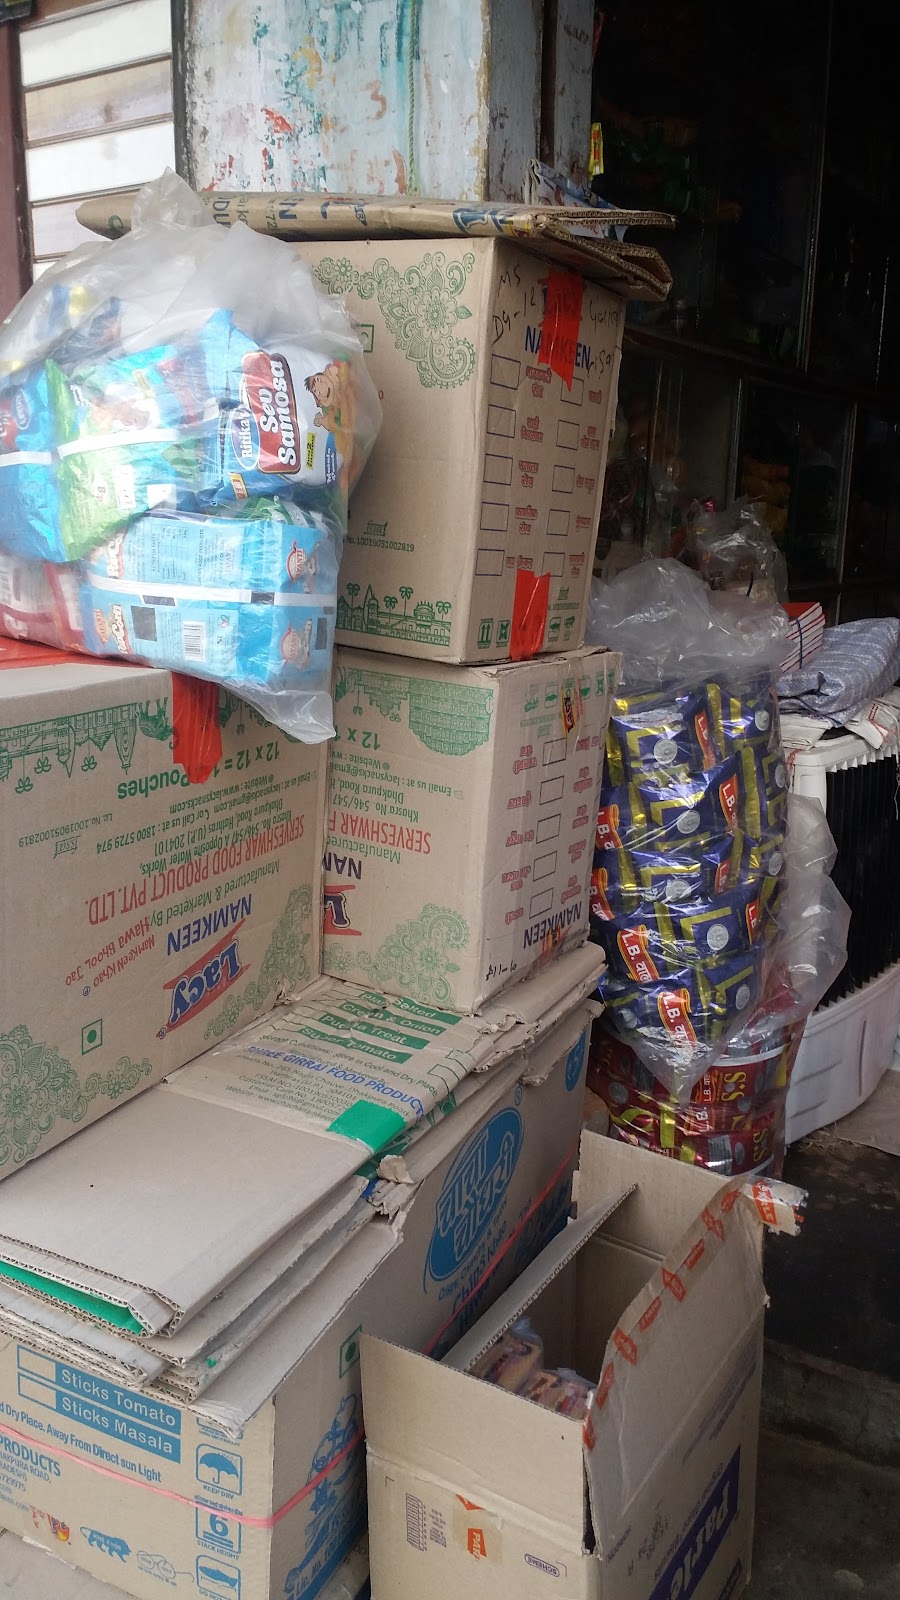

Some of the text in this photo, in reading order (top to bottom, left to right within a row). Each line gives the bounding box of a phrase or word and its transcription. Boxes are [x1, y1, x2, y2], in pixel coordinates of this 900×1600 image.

[270, 360, 297, 466] Samosa
[347, 728, 357, 742] x
[362, 731, 381, 750] 12
[237, 750, 250, 770] 12
[266, 741, 280, 760] 12
[350, 754, 381, 770] Website
[117, 769, 190, 800] Pouches
[406, 778, 415, 788] at
[417, 781, 427, 791] us
[429, 782, 452, 797] Email
[169, 775, 268, 814] Website www.lacysnacks.com
[362, 786, 404, 805] Dhakpura
[722, 784, 734, 813] L.B.
[185, 813, 196, 827] Call
[332, 798, 419, 823] Khasra No. 546/547
[137, 824, 156, 840] 1800
[162, 821, 170, 832] at
[172, 819, 181, 828] us
[208, 815, 235, 834] Hathras
[341, 813, 432, 855] SERVESHWAR
[97, 839, 112, 854] 974
[115, 831, 134, 849] 5729
[154, 834, 185, 857] 204101
[193, 838, 223, 858] Opposite
[246, 814, 305, 861] SERVESHWAR
[169, 848, 192, 866] Water
[213, 841, 242, 876] FOOD
[139, 858, 167, 879] Works,
[151, 853, 209, 902] PRODUCT
[225, 860, 280, 890] Manufactured
[119, 878, 147, 915] PVT.
[216, 886, 222, 896] &
[85, 891, 115, 926] LTD.
[167, 892, 212, 926] Marketed
[118, 917, 150, 948] Hawa
[167, 893, 252, 956] NAMKEEN
[523, 901, 582, 949] NAMKEEN
[622, 933, 640, 961] L.B.
[65, 966, 84, 986] Jao
[93, 963, 116, 987] Khao
[169, 937, 242, 1025] Lacy
[393, 998, 436, 1019] Salted
[663, 993, 680, 1023] L.B.
[371, 1028, 407, 1045] Treat
[401, 1020, 440, 1035] Onion
[346, 1040, 397, 1060] Tomato
[283, 1055, 327, 1072] GIRRAJ
[327, 1067, 365, 1085] FOOD
[364, 1061, 381, 1071] Cool
[383, 1067, 400, 1077] and
[400, 1073, 414, 1084] Dry
[348, 1086, 384, 1106] Dhakpura
[704, 1088, 712, 1102] L.B.
[61, 1369, 176, 1427] Sticks Tomato
[62, 1397, 109, 1428] Sticks
[114, 1419, 173, 1454] Masala
[6, 1406, 20, 1422] Dry
[46, 1424, 69, 1445] Away
[70, 1434, 92, 1453] From
[93, 1443, 119, 1466] Direct
[121, 1458, 137, 1471] sun
[138, 1463, 162, 1483] Light
[203, 1484, 234, 1499] KEEP DRY
[210, 1513, 229, 1537] 6
[197, 1540, 240, 1560] STACK HEIGHT
[527, 1556, 558, 1576] SCHEME
